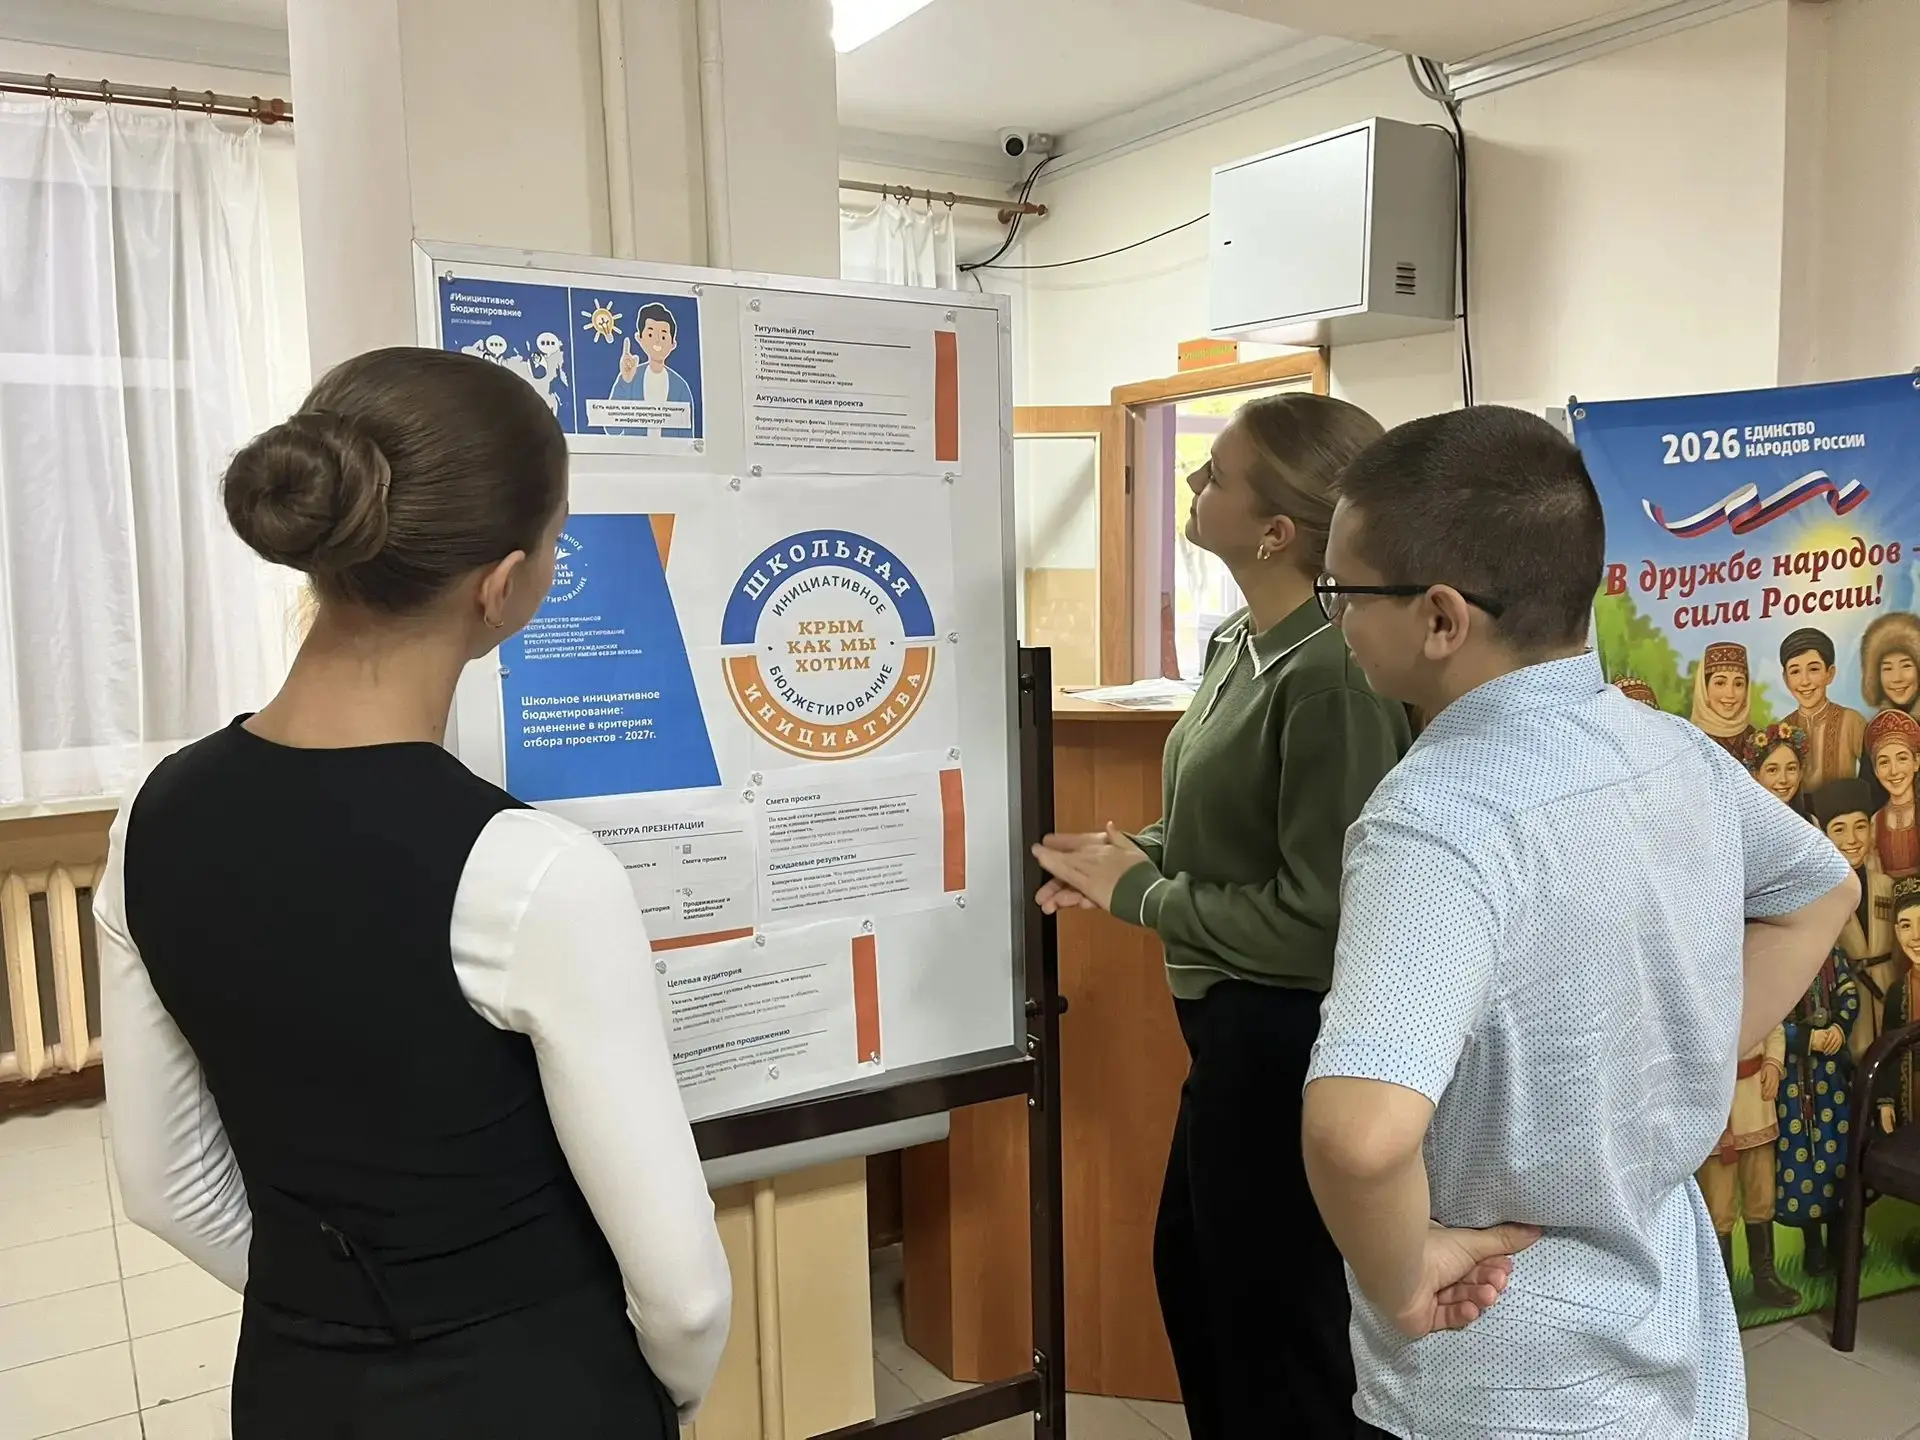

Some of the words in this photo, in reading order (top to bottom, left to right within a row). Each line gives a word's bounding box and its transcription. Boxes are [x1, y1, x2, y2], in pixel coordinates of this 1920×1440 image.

[449, 292, 515, 306] #Инициативное
[450, 303, 522, 317] Бюджетирование
[754, 324, 797, 334] Титульный
[756, 393, 807, 404] Актуальность
[1744, 421, 1815, 441] ЕДИНСТВО
[1661, 428, 1740, 465] 2026
[1745, 438, 1810, 458] НАРОДОВ
[1814, 433, 1866, 452] РОССИИ
[743, 539, 911, 601] ШКОЛЬНАЯ
[1604, 563, 1627, 596] В
[1639, 550, 1762, 600] дружбе
[1773, 537, 1902, 583] народов
[771, 575, 887, 617] ИНИЦИАТИВНОЕ
[1674, 598, 1750, 629] сила
[1759, 575, 1883, 620] России!
[798, 619, 864, 636] КРЫМ
[786, 639, 832, 654] КАК
[840, 637, 877, 651] МЫ
[795, 656, 871, 673] ХОТИМ
[769, 663, 893, 716] БЮДЖЕТИРОВАНИЕ
[521, 696, 580, 706] Школьное
[582, 691, 660, 703] инициативное
[522, 706, 624, 720] бюджетирование:
[743, 672, 921, 747] ИНИЦИАТИВА
[523, 723, 586, 734] изменение
[589, 722, 595, 730] в
[597, 718, 653, 731] критериях
[523, 736, 563, 748] отбора
[566, 734, 616, 746] проектов
[625, 730, 657, 741] 2027г.
[790, 794, 821, 804] проекта
[592, 826, 640, 838] ТРУКТУРА
[641, 821, 704, 833] ПРЕЗЕНТАЦИИ
[770, 859, 815, 871] Ожидаемые
[816, 854, 857, 865] результаты
[641, 905, 670, 915] удитория
[667, 977, 701, 988] Целевая
[702, 968, 742, 982] аудитория
[673, 1043, 725, 1060] Мероприятия
[736, 1029, 790, 1045] продвижению
